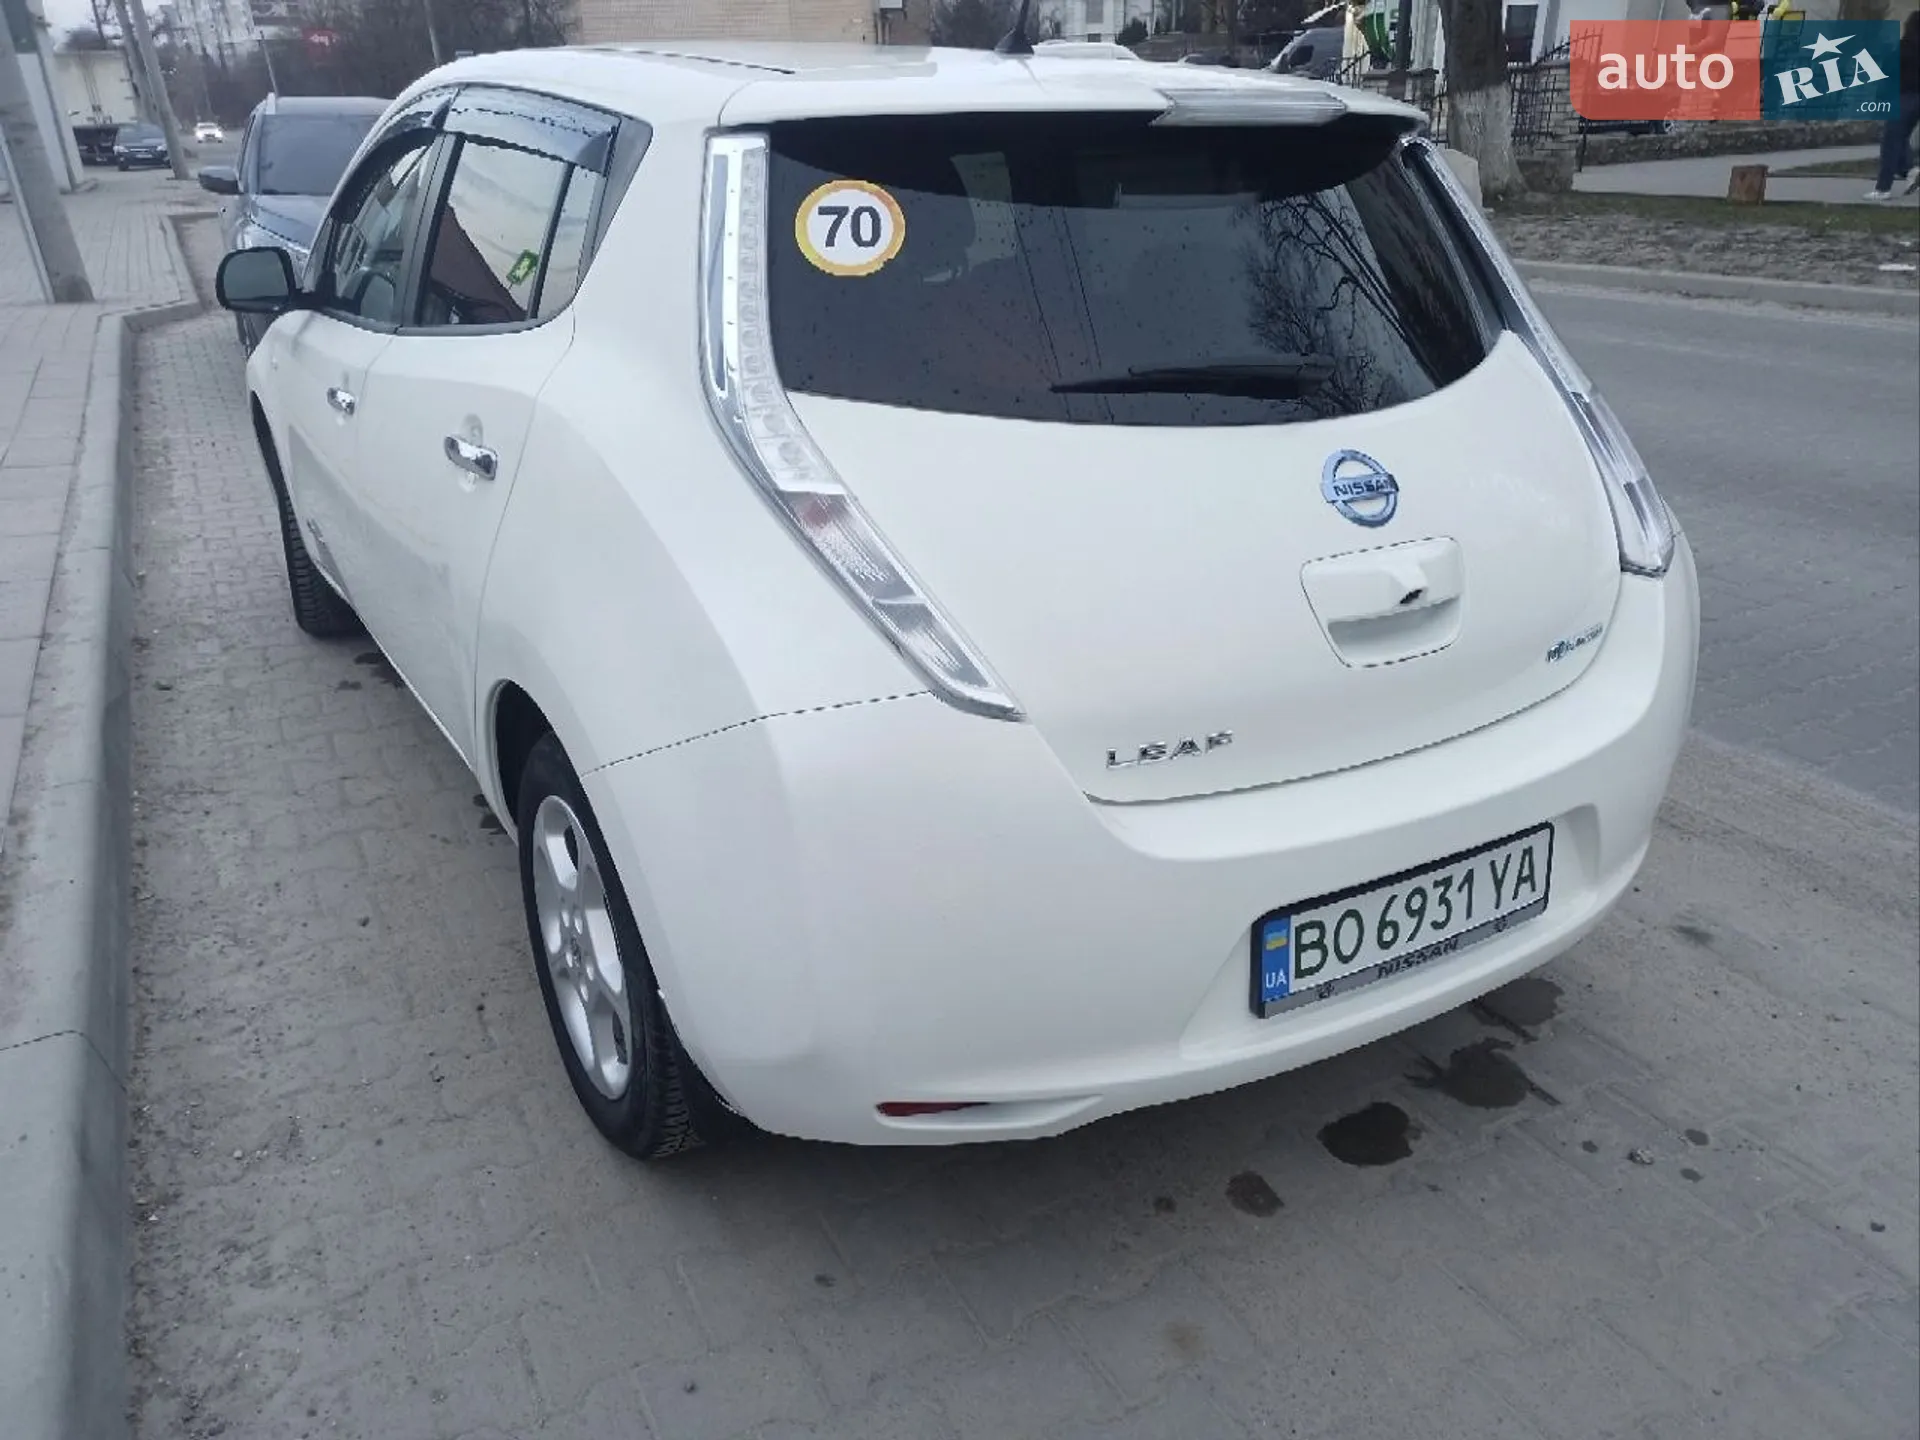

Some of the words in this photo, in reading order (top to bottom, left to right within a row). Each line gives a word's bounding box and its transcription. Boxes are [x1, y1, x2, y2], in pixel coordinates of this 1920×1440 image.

[817, 205, 882, 248] 70
[1105, 730, 1233, 768] LEAF
[1294, 908, 1364, 980] BO
[1376, 868, 1475, 950] 6931
[1489, 845, 1536, 910] YA
[1377, 937, 1459, 979] NISSAN
[1265, 973, 1288, 989] UA
